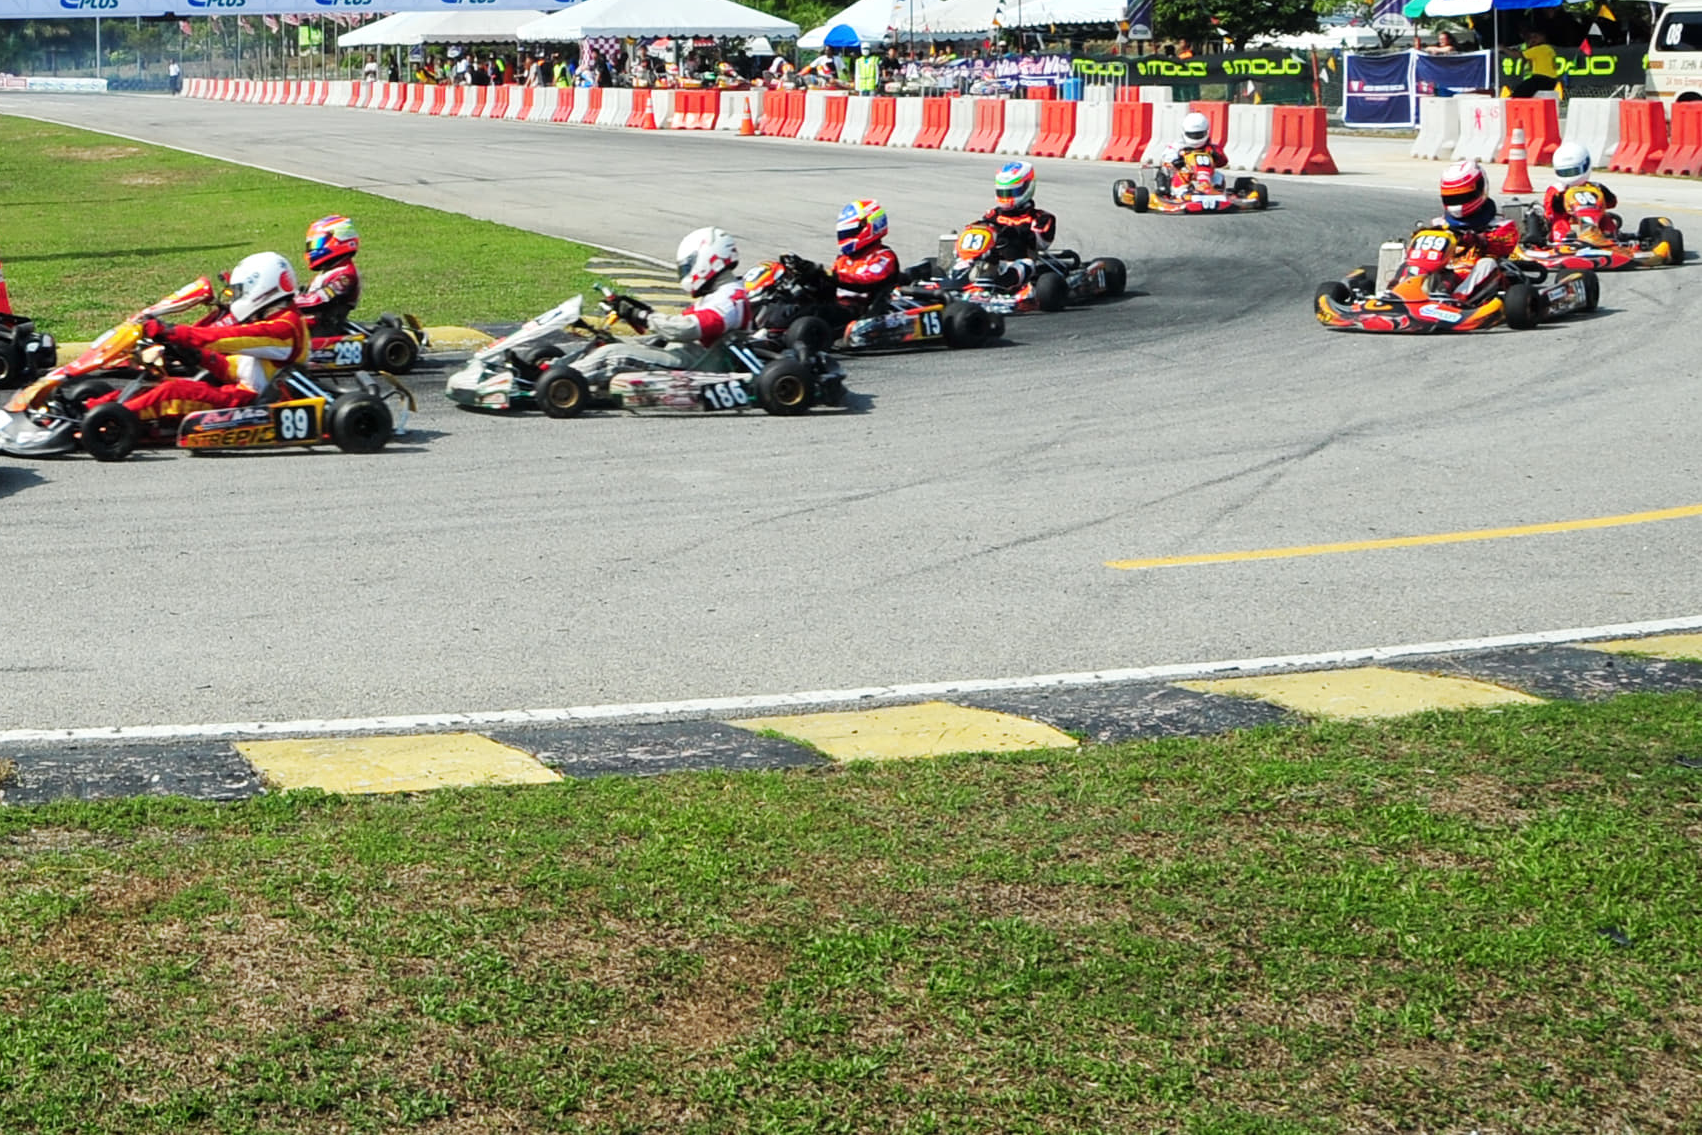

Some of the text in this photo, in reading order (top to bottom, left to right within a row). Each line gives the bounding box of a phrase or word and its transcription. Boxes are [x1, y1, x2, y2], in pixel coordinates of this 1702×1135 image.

[1666, 22, 1683, 45] 08
[1148, 61, 1208, 76] MOJO
[1233, 58, 1302, 75] MOJO
[1414, 235, 1446, 252] 159
[922, 311, 941, 336] 15
[333, 340, 363, 366] 298
[704, 379, 749, 410] 186
[280, 408, 309, 440] 89
